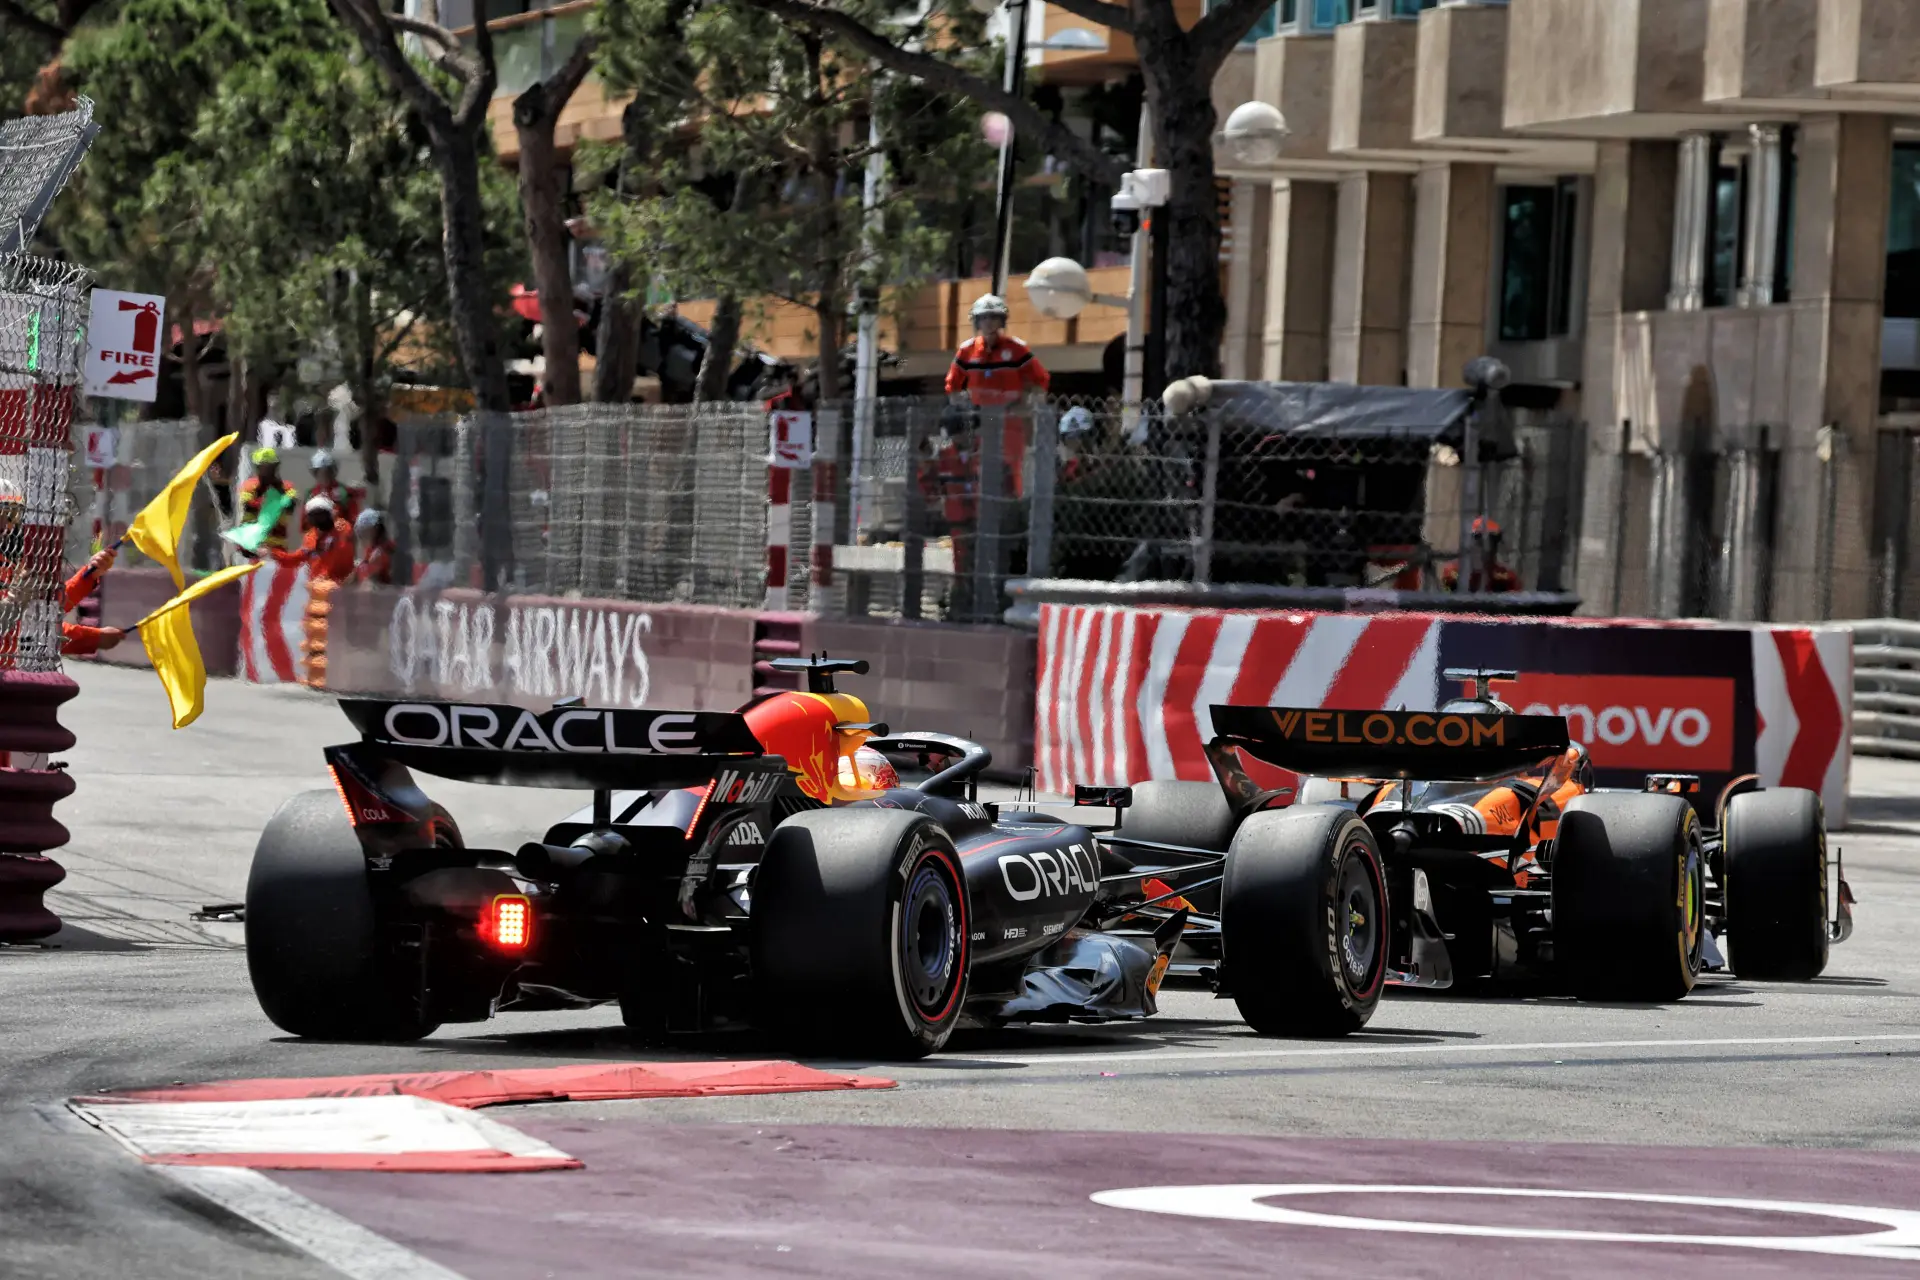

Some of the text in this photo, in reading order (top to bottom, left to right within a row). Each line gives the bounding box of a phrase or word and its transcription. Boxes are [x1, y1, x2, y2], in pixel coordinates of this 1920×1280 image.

[100, 350, 154, 367] FIRE
[505, 605, 651, 708] AIRWAYS
[384, 703, 702, 754] ORACLE
[1270, 709, 1505, 747] VELO.COM
[1490, 691, 1711, 747] novo
[710, 770, 769, 803] Mobil
[363, 808, 389, 820] COLA
[727, 821, 765, 845] NDA
[972, 932, 986, 941] AGON
[1043, 923, 1065, 936] SIEMENS
[1327, 906, 1351, 997] ZERO
